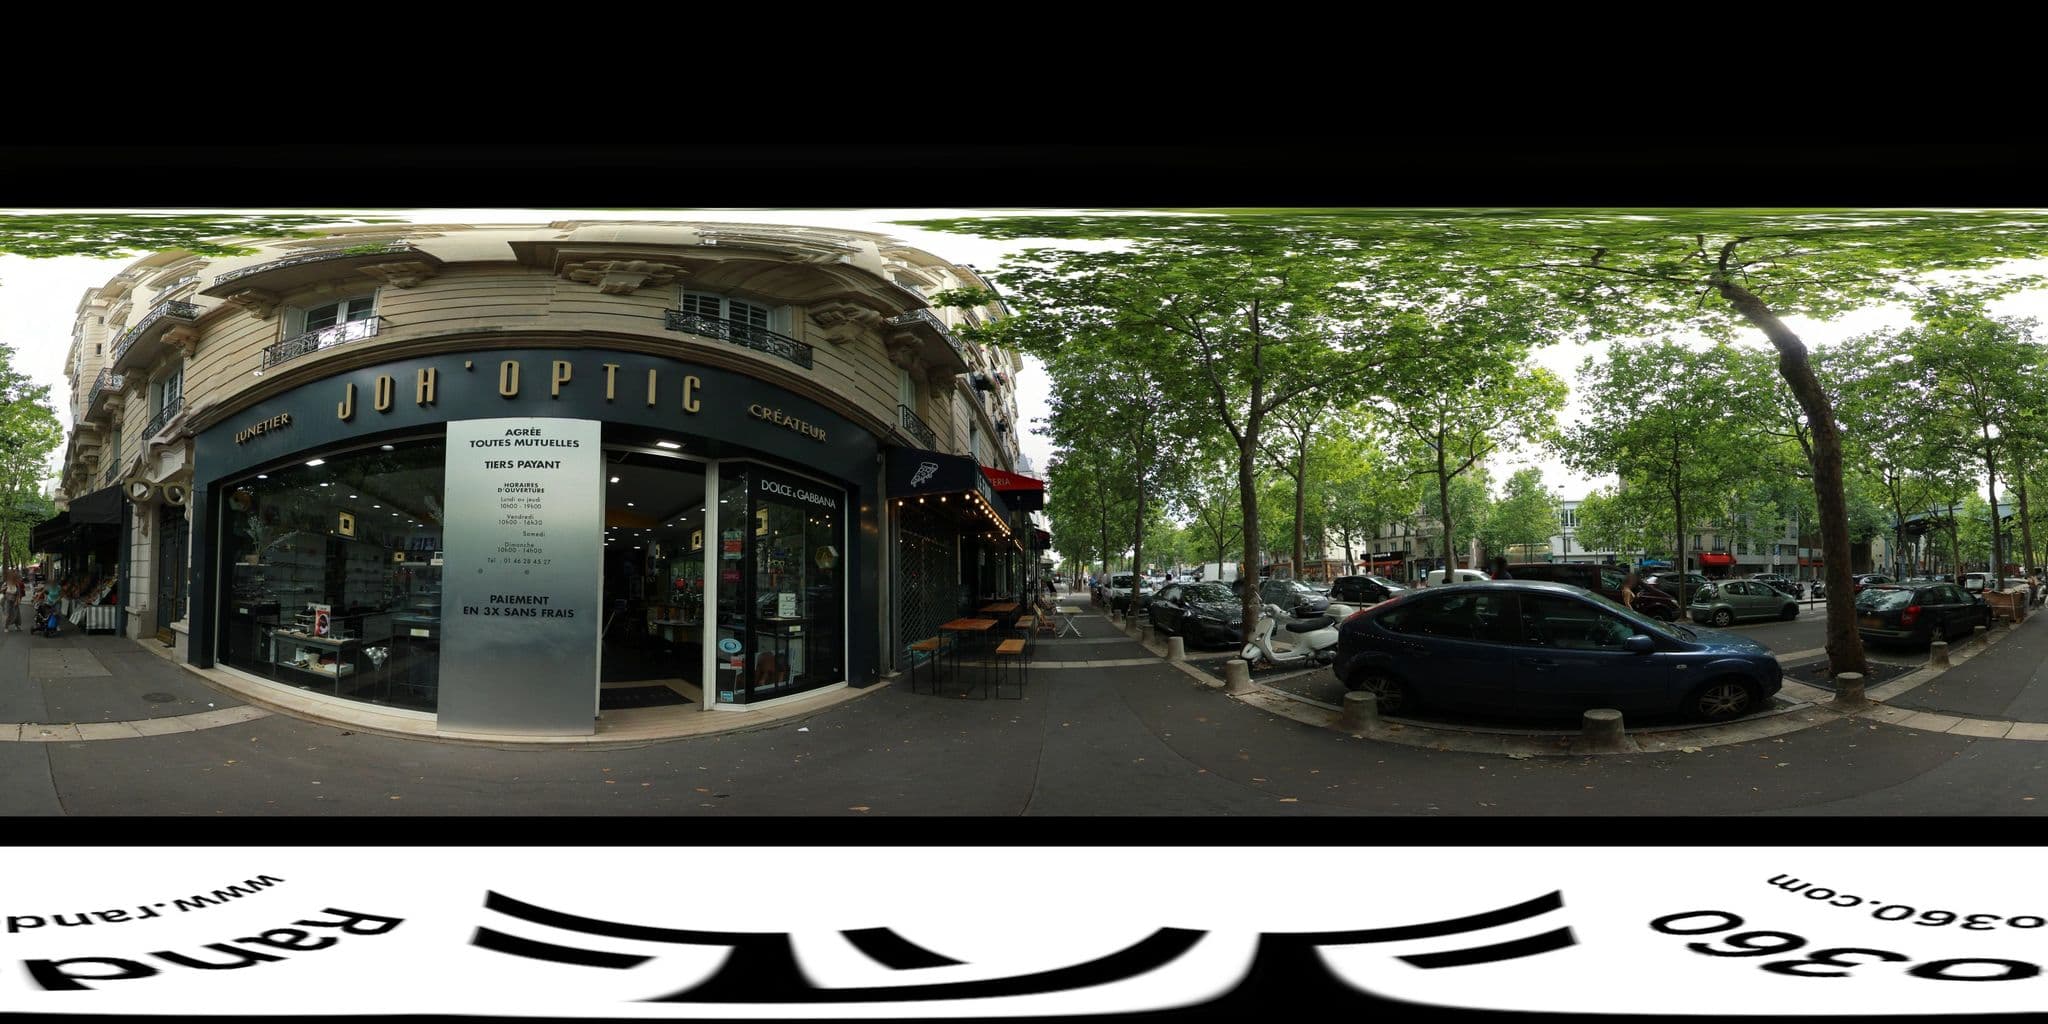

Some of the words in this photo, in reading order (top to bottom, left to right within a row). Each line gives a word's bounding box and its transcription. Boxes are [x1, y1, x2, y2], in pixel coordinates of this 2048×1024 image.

[337, 359, 702, 420] JOH'OPTIC
[235, 412, 290, 444] LUNETIER
[749, 403, 827, 442] CRÉATEUR
[505, 426, 542, 436] AGRÉE
[469, 439, 511, 448] TOUTES
[514, 439, 580, 448] MUTUELLES
[484, 460, 514, 469] TIERS
[517, 460, 561, 469] PAYANT
[761, 479, 792, 497] DOLCE
[797, 489, 836, 509] GABBANA
[489, 594, 550, 605] PAIEMENT
[463, 606, 479, 615] EN
[484, 606, 500, 616] 3X
[504, 607, 537, 617] SANS
[541, 608, 575, 618] FRAIS
